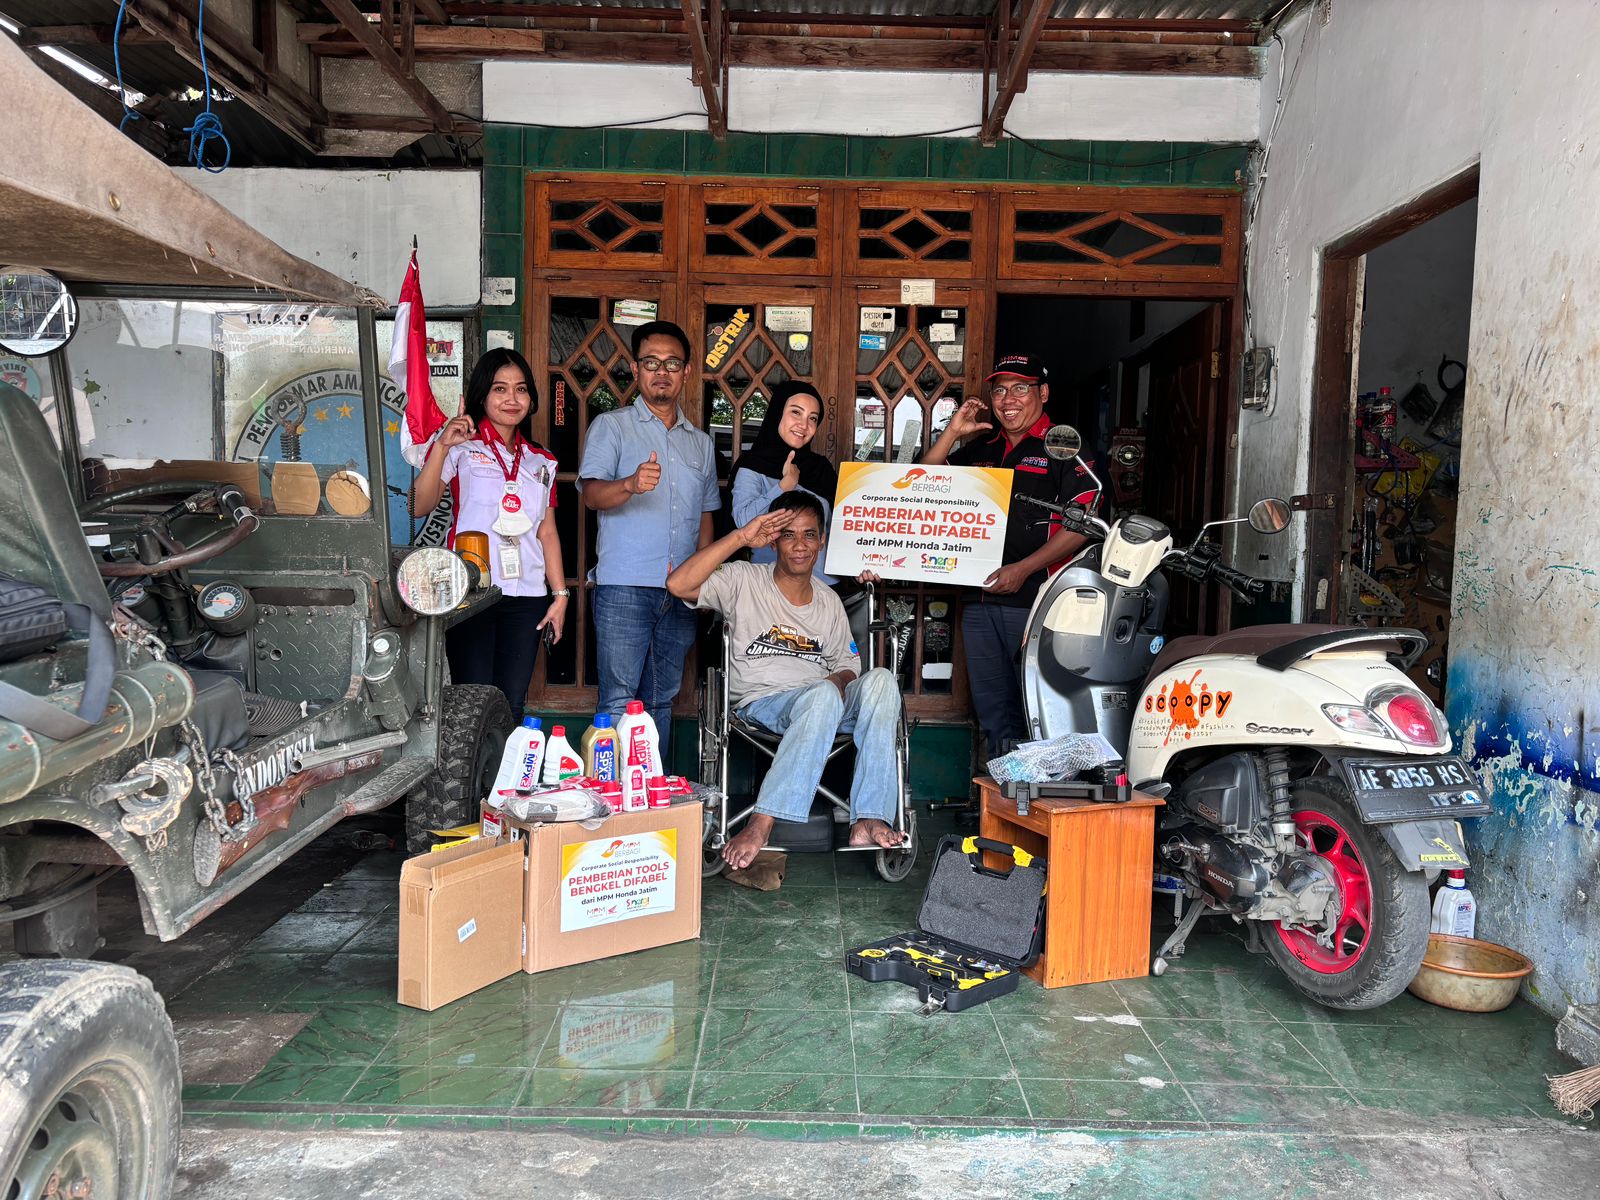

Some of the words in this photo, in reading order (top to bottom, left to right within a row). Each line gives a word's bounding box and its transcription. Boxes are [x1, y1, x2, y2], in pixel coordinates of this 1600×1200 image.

[705, 308, 750, 368] DISTRIK
[431, 366, 457, 376] JUAN
[925, 474, 952, 484] MPM
[912, 483, 951, 493] BERBAGI
[861, 494, 899, 503] Corporate
[900, 496, 923, 504] Social
[924, 497, 980, 508] Responsibility
[842, 505, 937, 522] PEMBERIAN
[941, 510, 996, 526] TOOLS
[843, 519, 916, 536] BENGKEL
[920, 523, 991, 540] DIFABEL
[856, 537, 876, 547] dari
[878, 538, 903, 548] MPM
[905, 540, 940, 551] Honda
[942, 542, 972, 553] Jatim
[862, 553, 889, 563] MPM
[1359, 768, 1384, 790] AE
[1436, 764, 1464, 785] HS
[614, 848, 641, 858] BERBAGI
[623, 841, 640, 849] MPM
[581, 863, 607, 872] Corporate
[608, 860, 623, 868] Social
[624, 855, 659, 865] Responsibility
[569, 868, 633, 887] PEMBERIAN
[636, 861, 669, 875] TOOLS
[1208, 869, 1235, 889] HONDA
[570, 881, 621, 897] BENGKEL
[624, 872, 667, 888] DIFABEL
[581, 897, 595, 906] dari
[597, 893, 614, 903] MPM
[615, 890, 638, 899] Honda
[639, 886, 658, 895] Jatim
[586, 907, 605, 916] MPM
